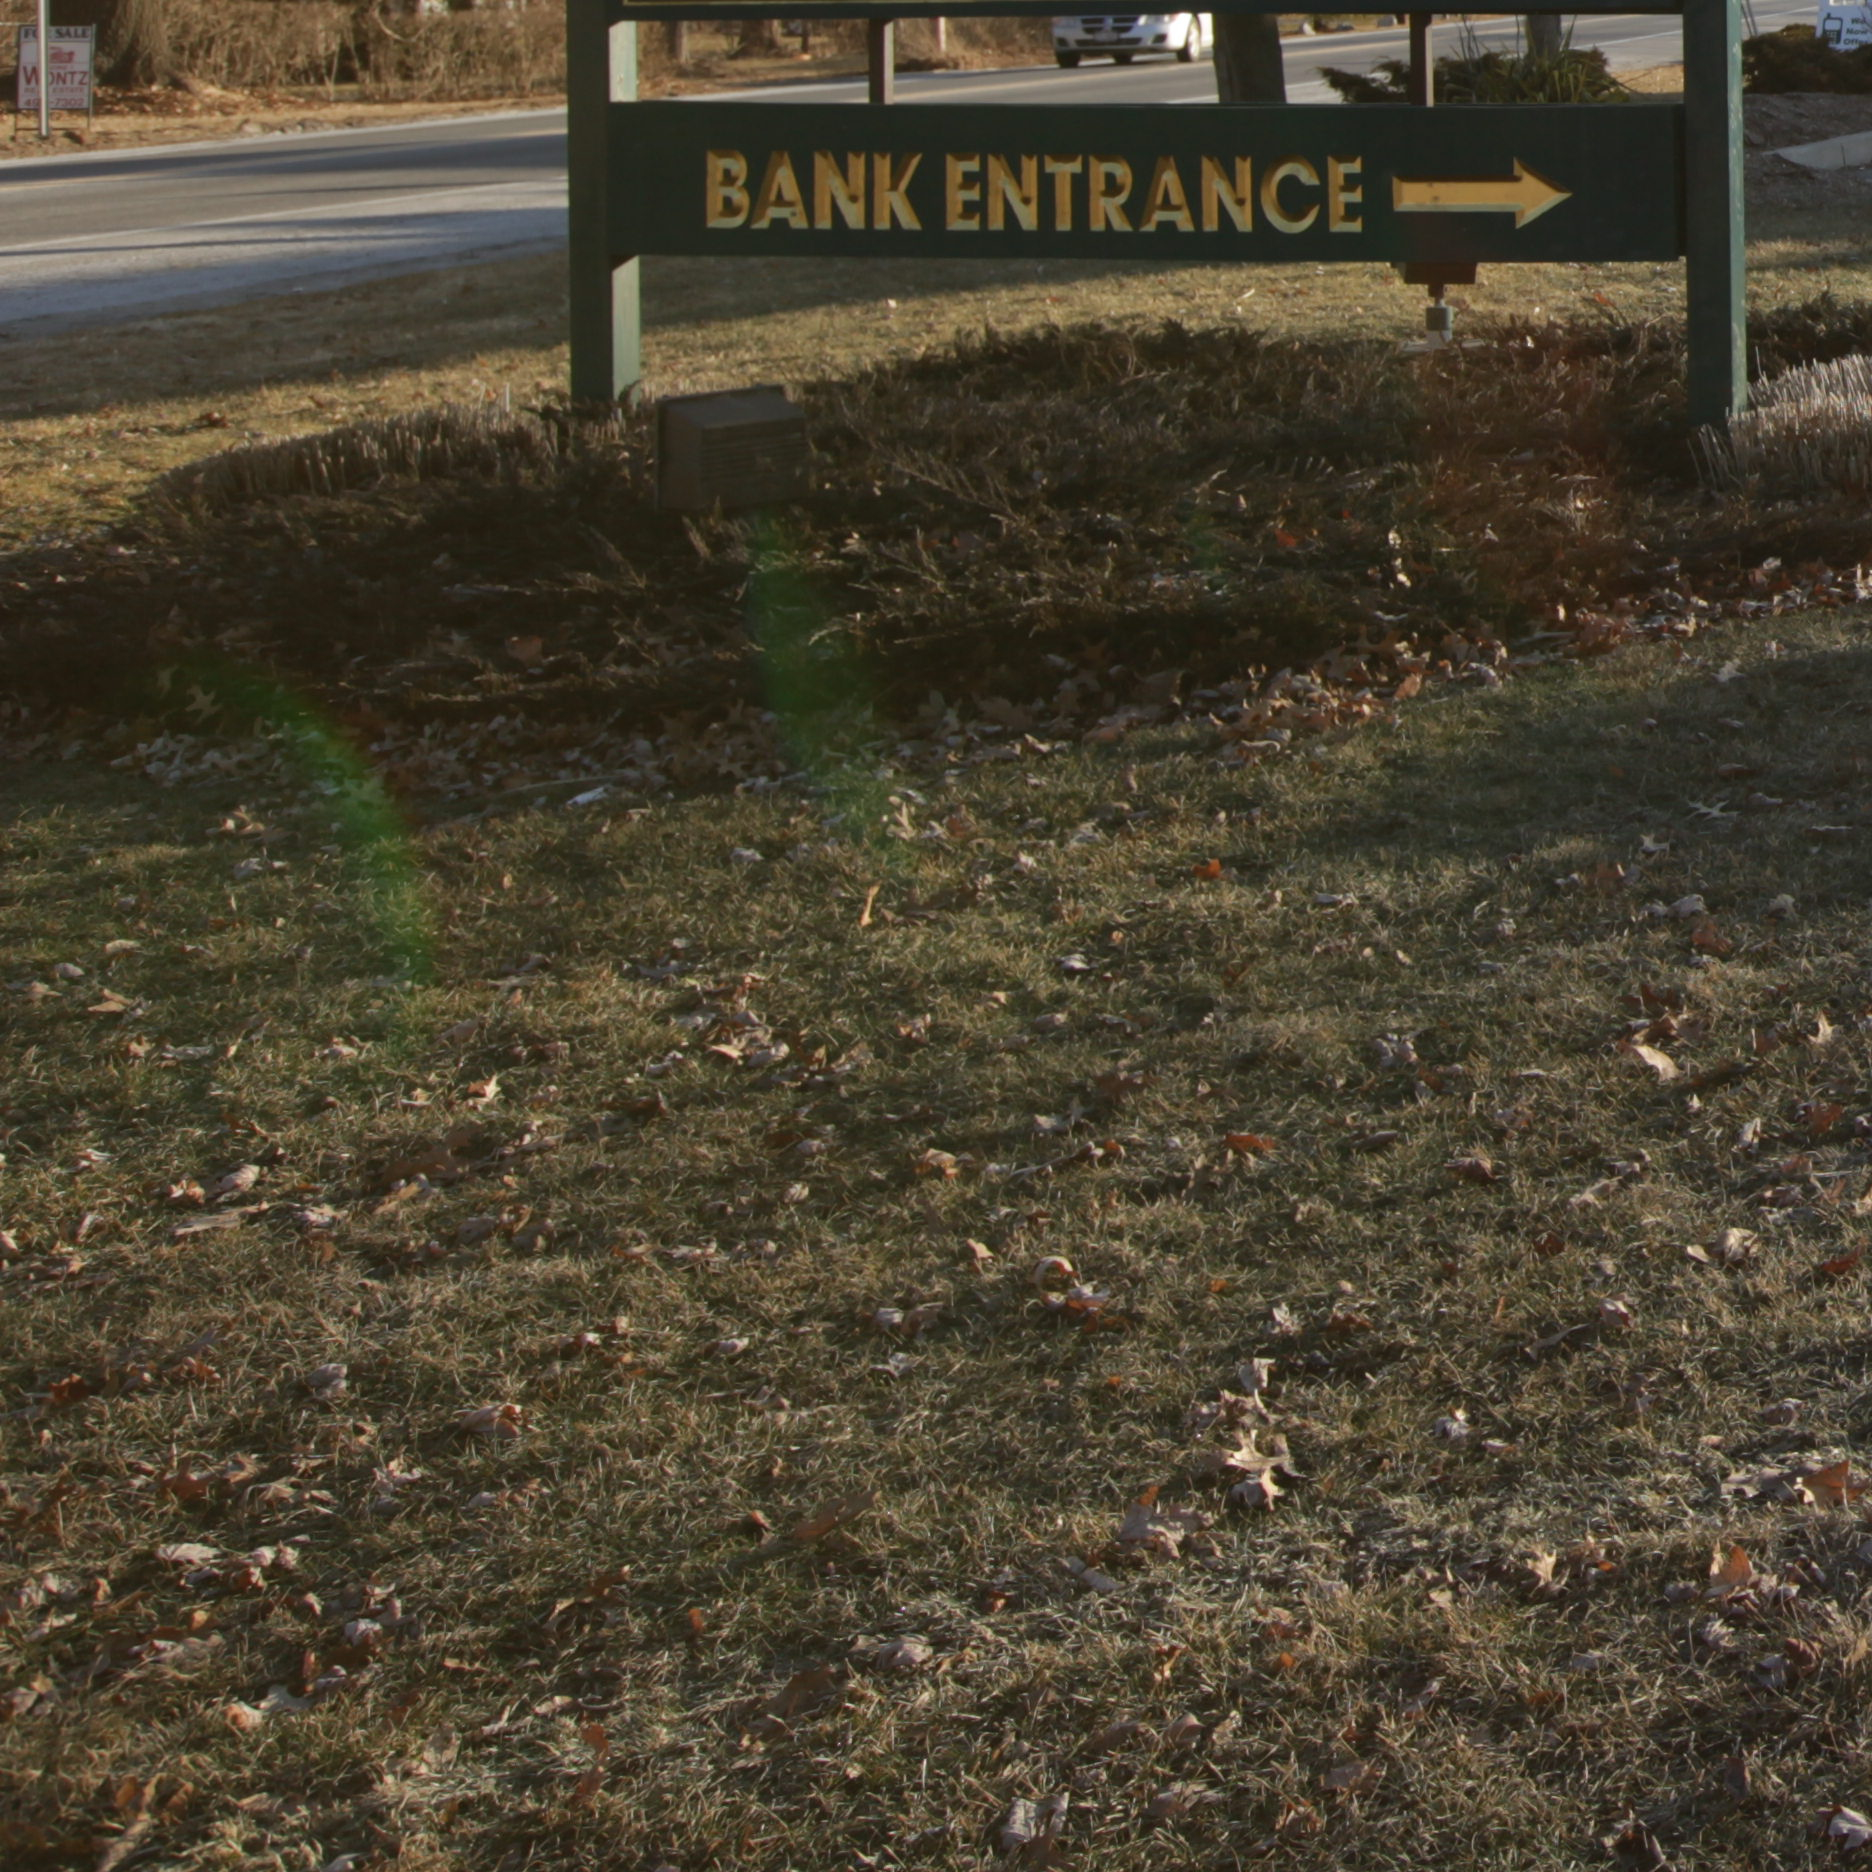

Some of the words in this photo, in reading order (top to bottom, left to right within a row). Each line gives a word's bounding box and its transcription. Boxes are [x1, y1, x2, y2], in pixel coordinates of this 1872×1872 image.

[55, 28, 89, 39] SALE
[705, 148, 924, 231] BANK
[944, 153, 1364, 233] ENTRANCE
